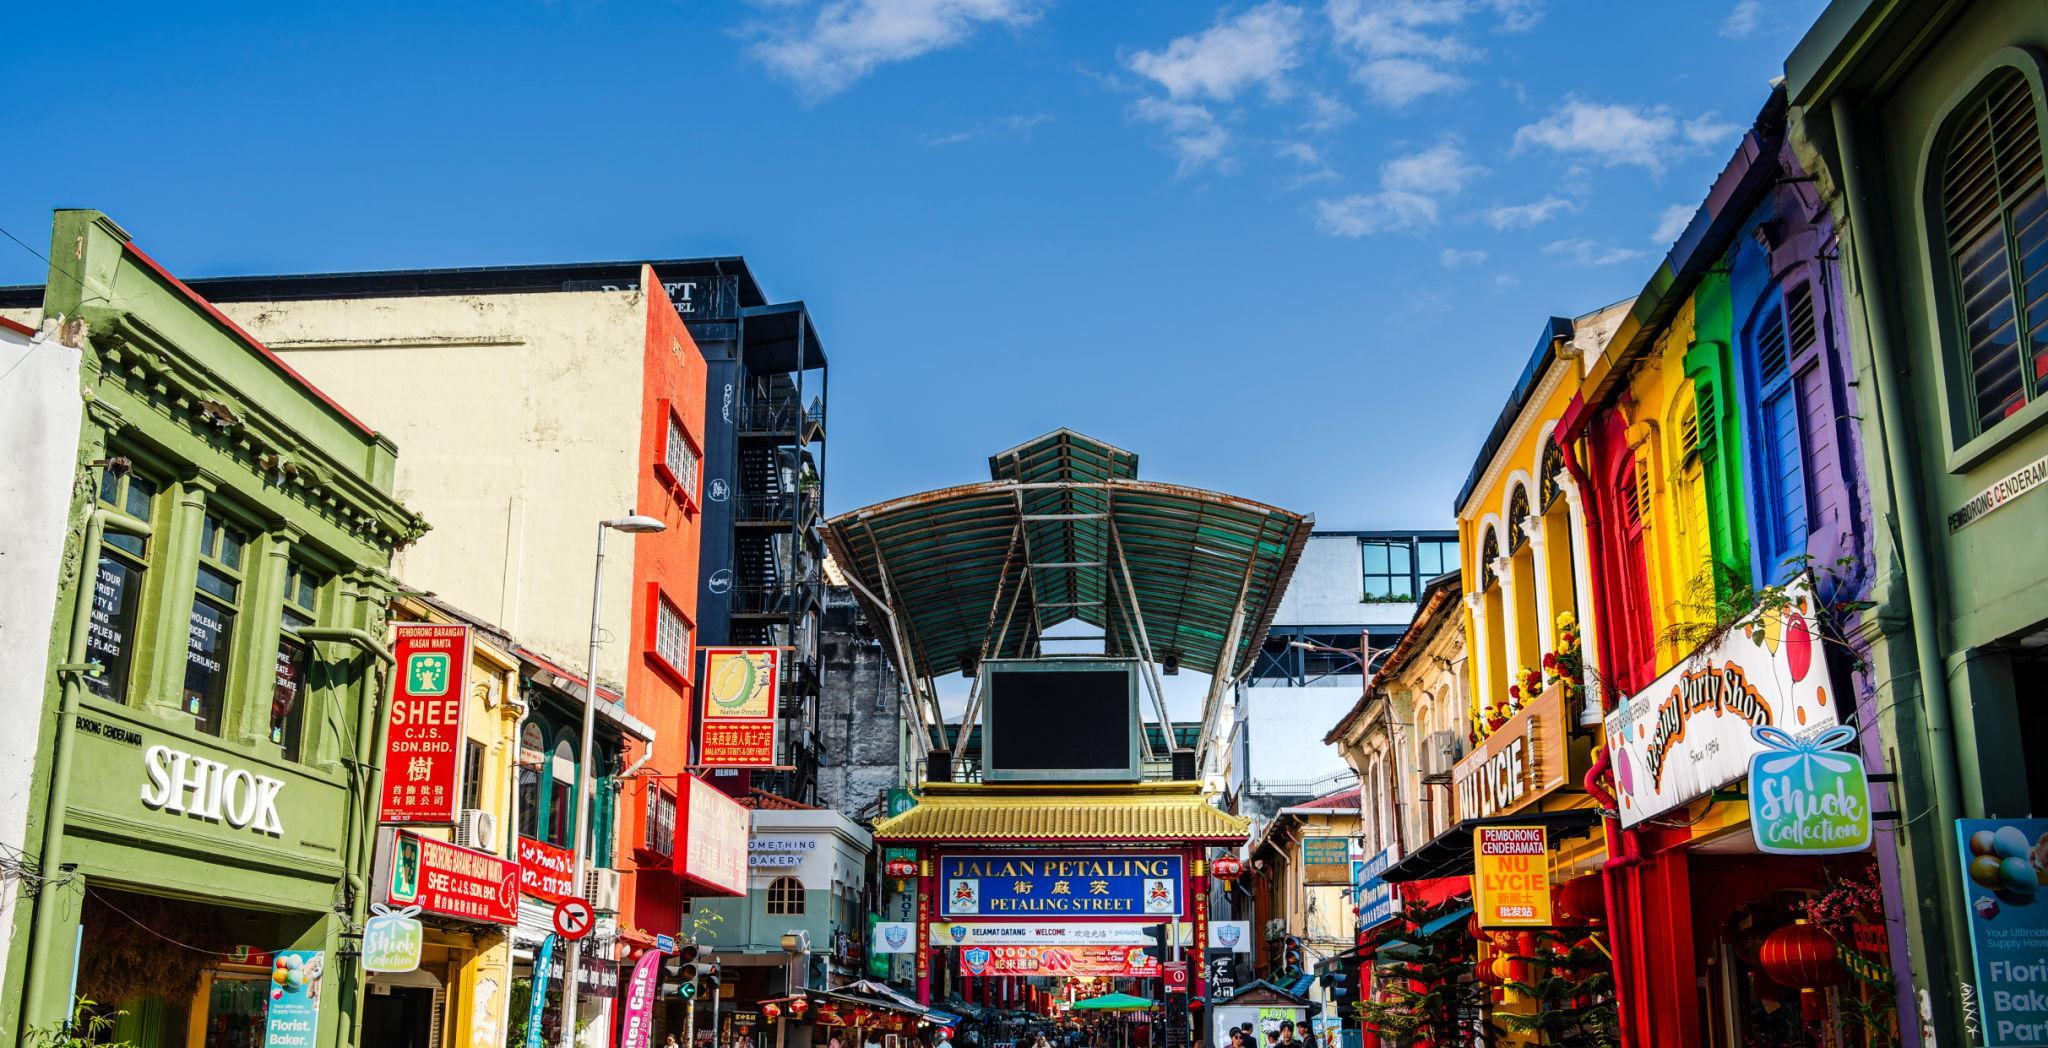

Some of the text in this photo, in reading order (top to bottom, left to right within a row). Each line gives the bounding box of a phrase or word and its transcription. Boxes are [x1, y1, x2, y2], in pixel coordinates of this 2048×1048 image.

[1947, 491, 1994, 533] PEMBORONG
[102, 570, 121, 587] YOUR
[107, 601, 113, 611] &
[94, 637, 119, 656] PLACE!
[1681, 667, 1721, 716] Party
[391, 700, 459, 726] SHEE
[720, 708, 766, 717] Native Product
[404, 728, 441, 739] C.J.S.
[1480, 737, 1524, 818] LYCIE
[140, 745, 285, 836] SHIOK
[393, 796, 444, 806] 有限公司
[1760, 776, 1864, 821] Shiok
[1485, 829, 1540, 842] PEMBORONG
[1768, 818, 1862, 846] Collection
[1482, 842, 1545, 854] CENDERAMATA
[750, 856, 803, 865] BAKERY
[1498, 856, 1529, 873] NU
[953, 860, 1169, 878] JALAN PETALING
[428, 871, 449, 893] SHEE
[1484, 874, 1545, 891] LYCIE
[990, 898, 1133, 911] PETALING STREET
[1500, 906, 1533, 917] 批发站
[972, 928, 1000, 936] SELAMAT
[1001, 928, 1026, 936] DATANG
[1035, 928, 1066, 936] WELCOME
[1986, 928, 2009, 938] Your
[1987, 939, 2021, 950] Supply
[630, 967, 649, 1010] Cafe
[271, 1019, 311, 1031] Florist.
[269, 1033, 308, 1046] Baker.
